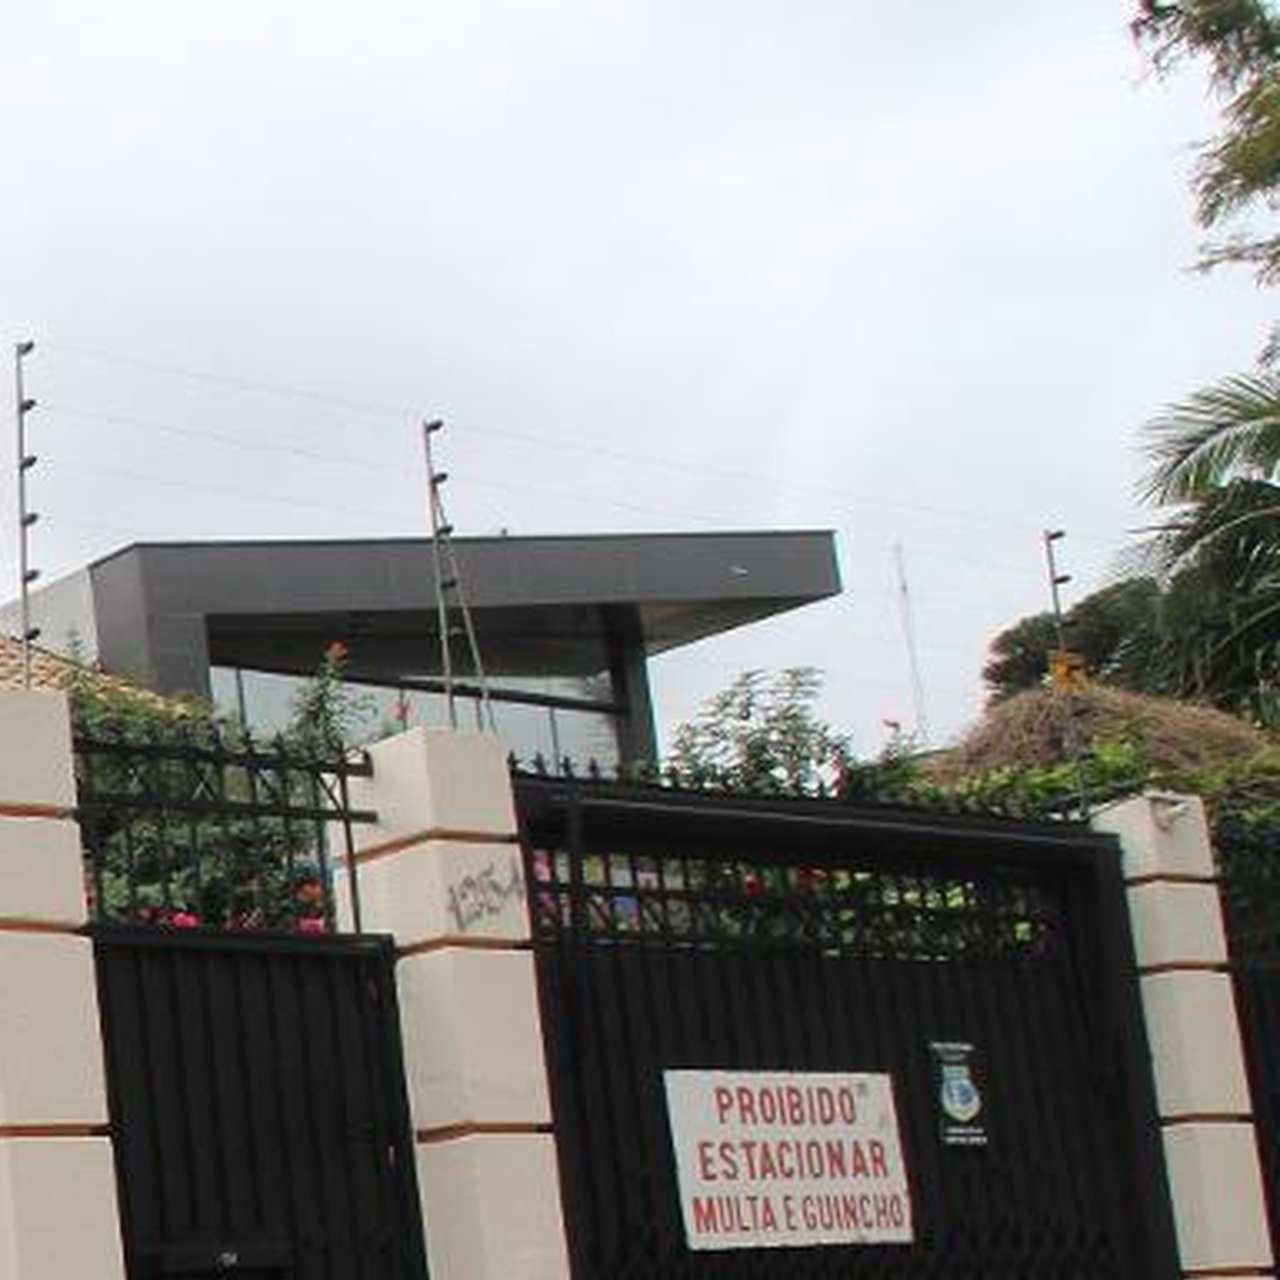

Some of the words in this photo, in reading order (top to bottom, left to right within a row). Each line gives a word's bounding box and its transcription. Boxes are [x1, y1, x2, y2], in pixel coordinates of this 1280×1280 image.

[714, 1086, 856, 1126] PROIBIDO
[697, 1139, 889, 1181] ESTACIONAR
[692, 1196, 777, 1234] MULTA
[783, 1195, 798, 1231] E
[802, 1194, 905, 1230] GUINCHO
